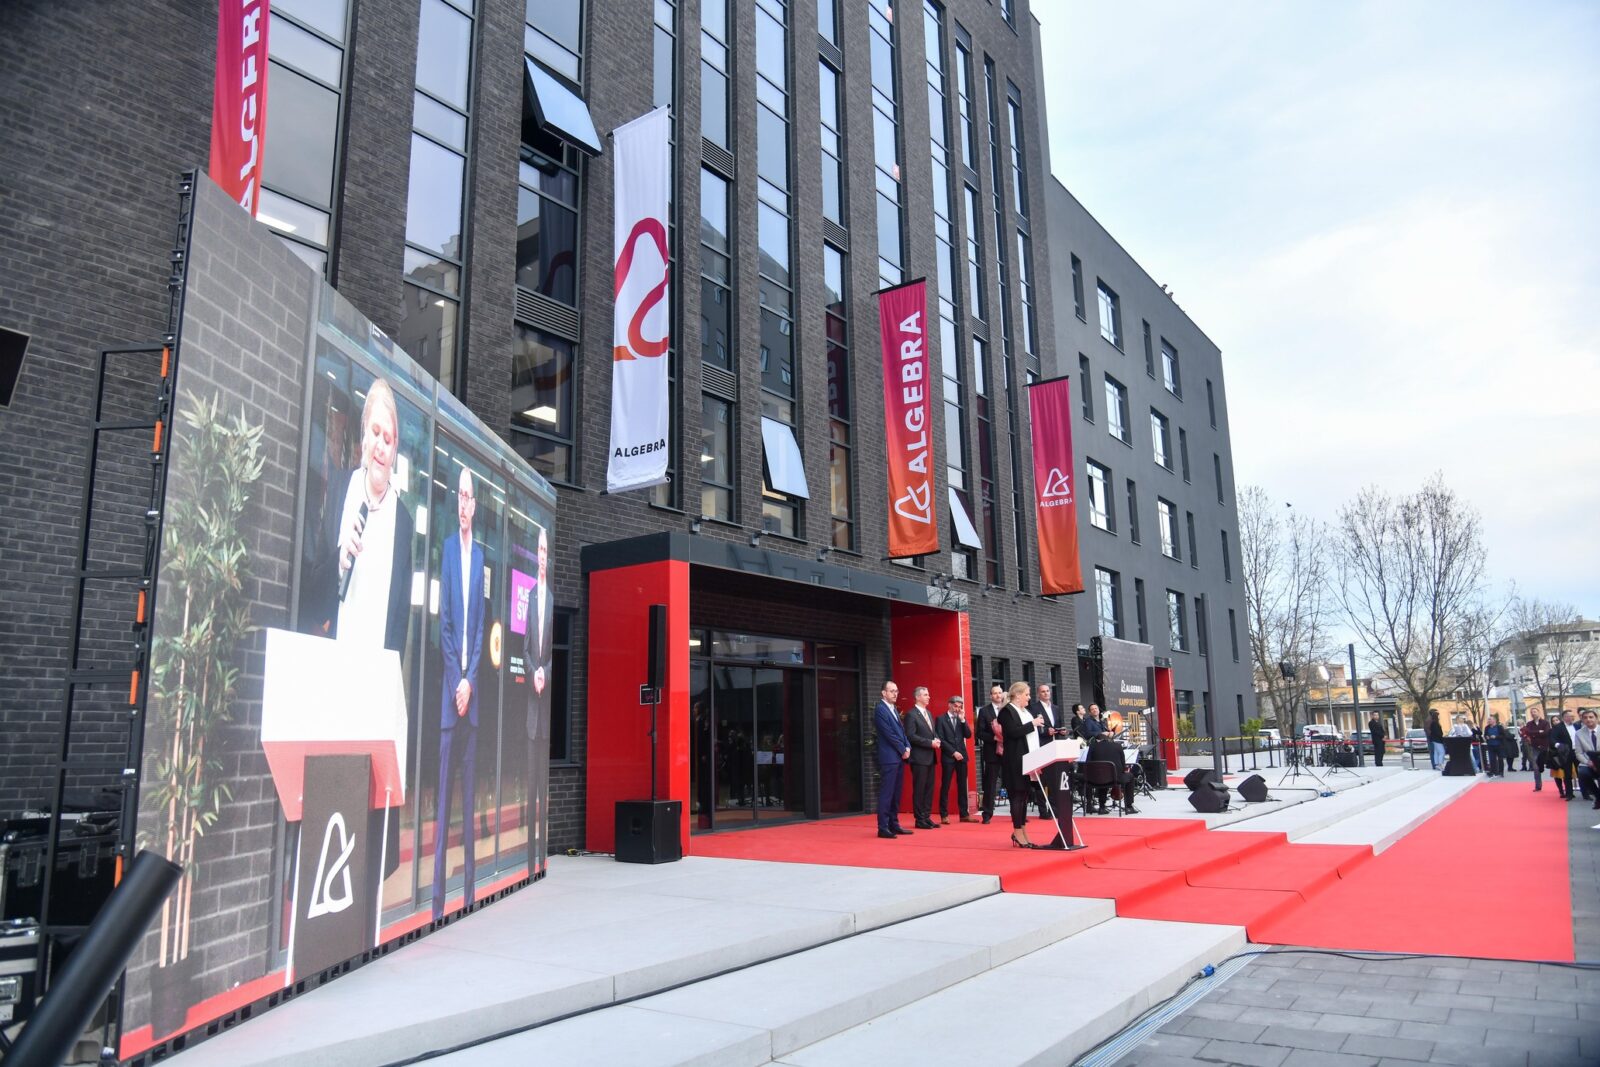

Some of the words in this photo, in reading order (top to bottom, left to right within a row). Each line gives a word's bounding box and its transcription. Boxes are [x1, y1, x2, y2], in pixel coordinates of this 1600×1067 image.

[900, 311, 927, 473] ALGEBRA
[614, 438, 666, 458] ALGEBRA
[1040, 497, 1073, 507] ALGEBRA
